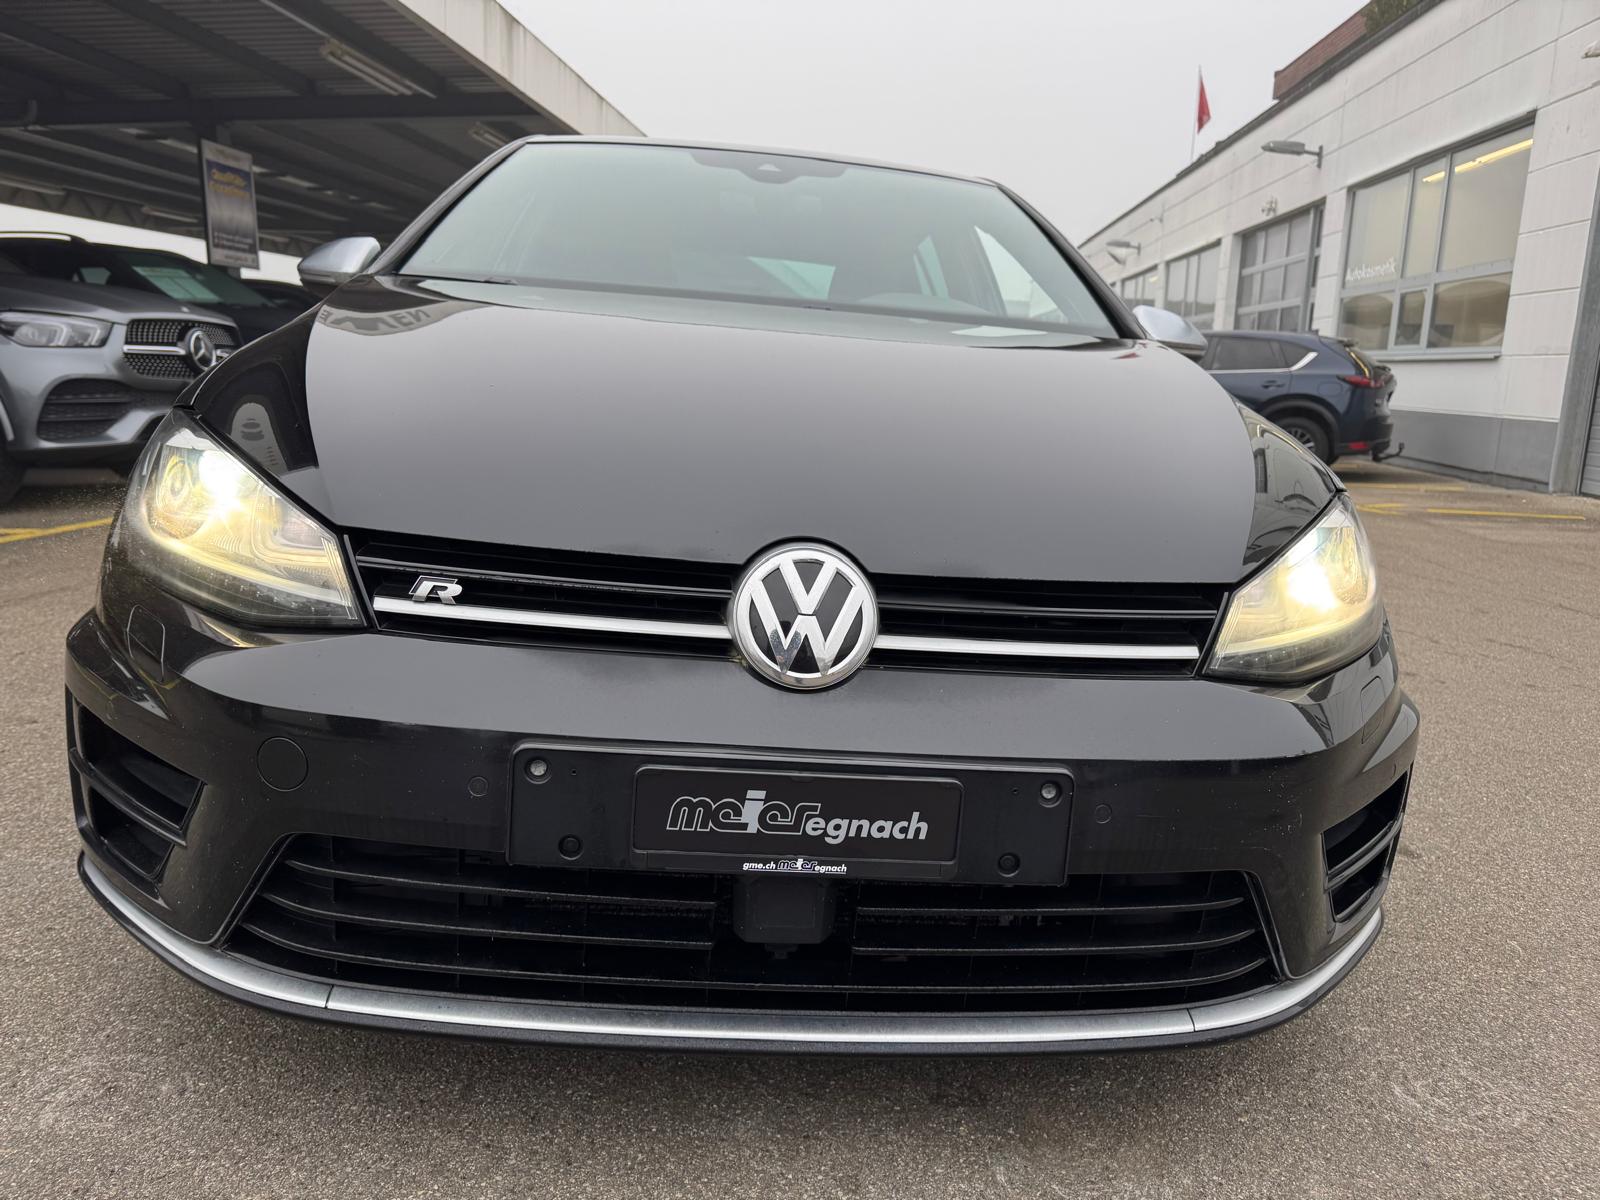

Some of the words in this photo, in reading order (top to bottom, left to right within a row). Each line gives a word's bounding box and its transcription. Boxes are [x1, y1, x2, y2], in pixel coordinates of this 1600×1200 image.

[409, 575, 463, 605] R
[744, 551, 870, 681] VW
[804, 811, 930, 845] egnach
[813, 863, 848, 874] egnach
